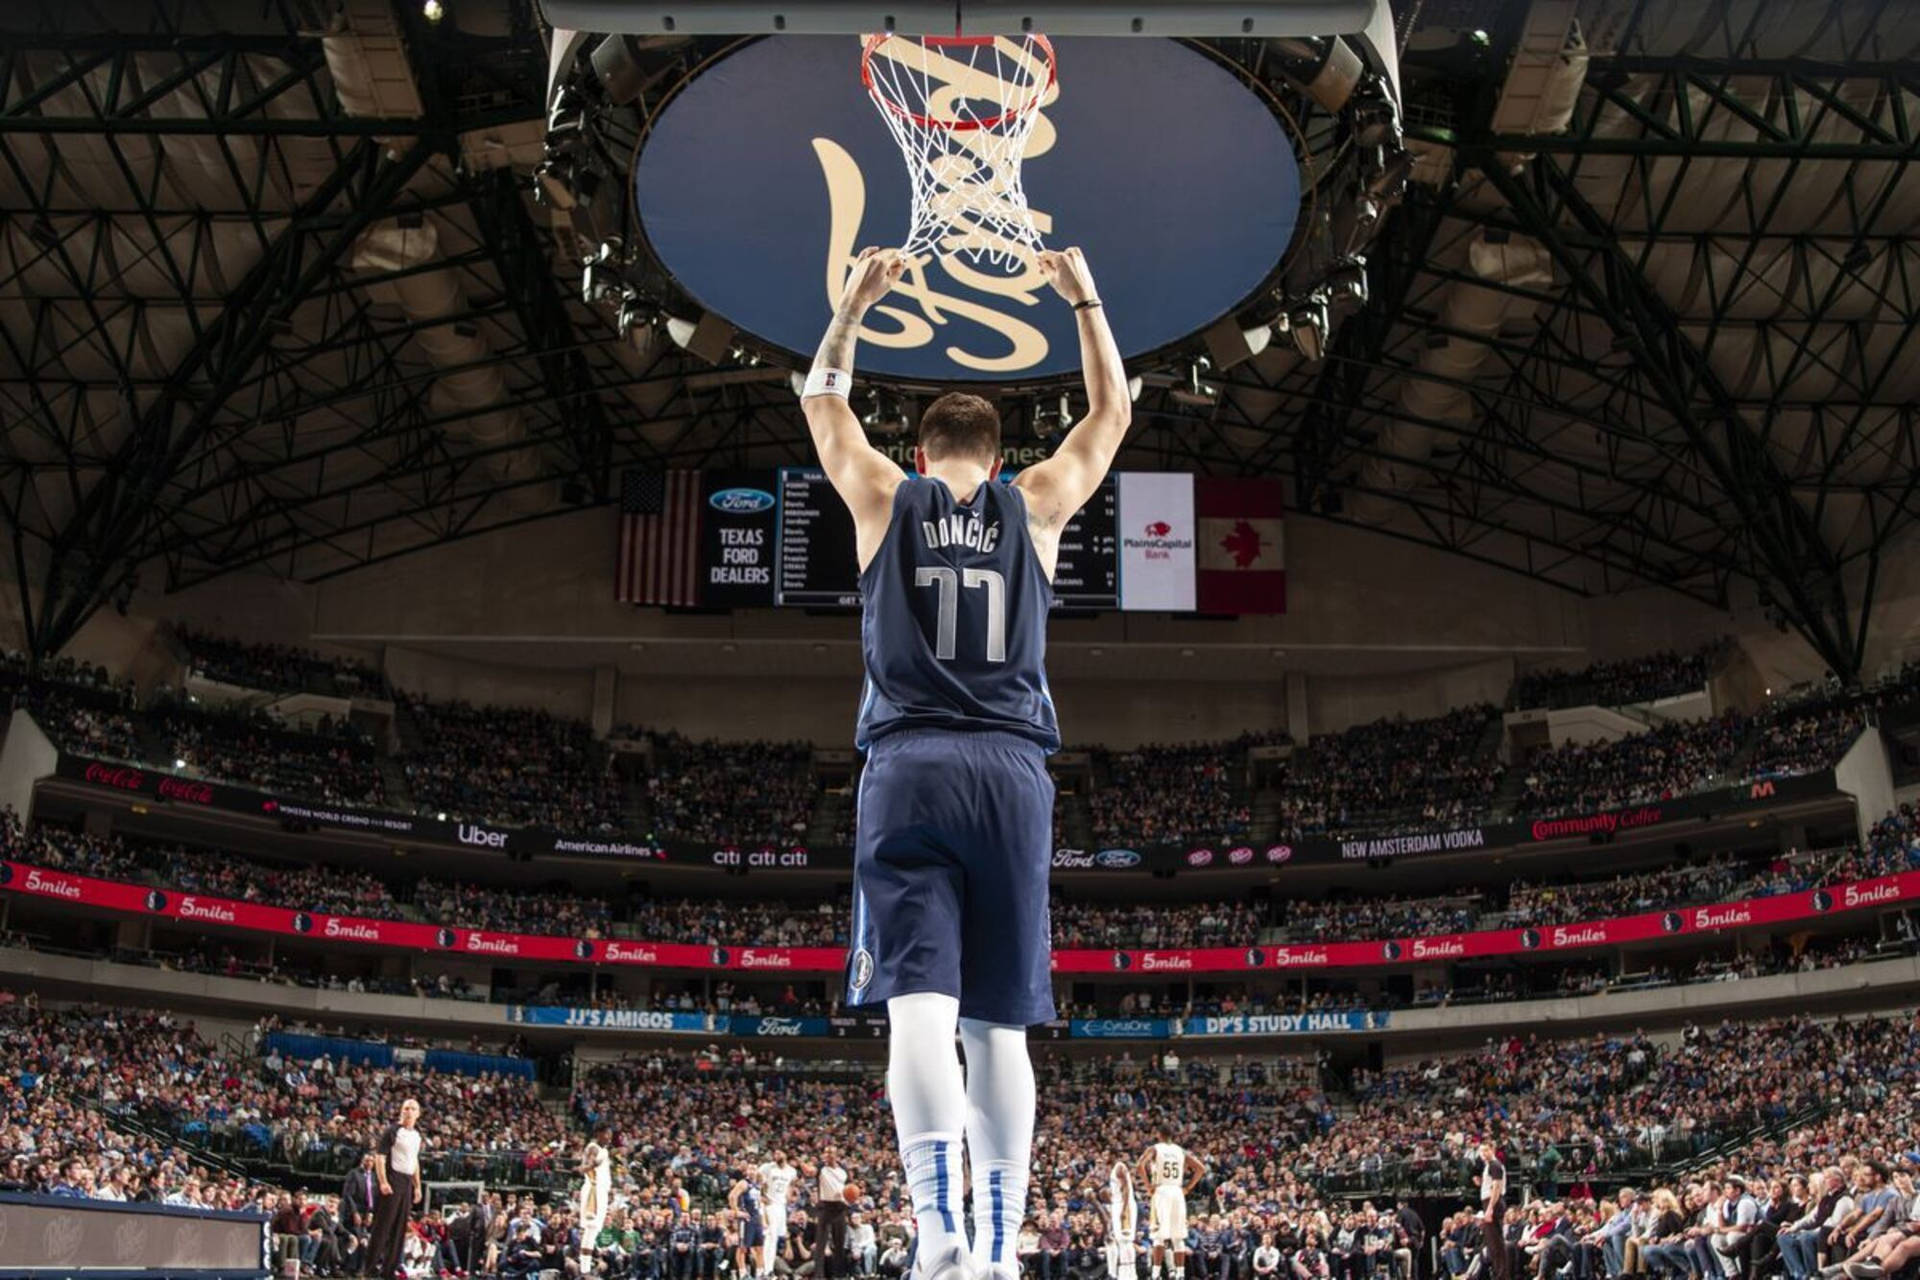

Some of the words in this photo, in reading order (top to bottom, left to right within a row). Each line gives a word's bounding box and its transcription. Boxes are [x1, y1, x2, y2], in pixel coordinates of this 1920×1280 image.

[719, 528, 764, 545] TEXAS
[922, 511, 1000, 553] DONČIĆ
[1123, 538, 1192, 550] PlainsCapital
[723, 547, 759, 564] FORD
[1144, 549, 1170, 560] Bank
[710, 567, 770, 584] DEALERS
[914, 565, 1006, 663] 77
[312, 811, 340, 821] WORLD
[458, 823, 509, 848] Uber
[1532, 812, 1618, 841] Community
[1342, 841, 1368, 858] NEW
[1369, 834, 1442, 857] AMSTERDAM
[1443, 829, 1484, 848] VODKA
[713, 849, 740, 865] citi
[748, 850, 775, 866] citi
[781, 850, 807, 866] citi
[1052, 848, 1096, 868] Ford
[25, 870, 80, 899] 5miles
[1844, 887, 1900, 907] 5miles
[179, 897, 235, 921] 5miles
[1695, 909, 1751, 928] 5miles
[324, 919, 379, 940] 5miles
[1553, 927, 1607, 946] 5miles
[467, 933, 519, 954] 5miles
[605, 943, 657, 962] 5miles
[1412, 940, 1465, 958] 5miles
[741, 950, 791, 967] 5miles
[1142, 953, 1192, 970] 5miles
[1277, 948, 1328, 966] 5miles
[565, 1008, 602, 1026] JJ'S
[603, 1010, 675, 1029] AMIGOS
[757, 1016, 802, 1036] Ford
[1206, 1017, 1244, 1033] DP'S
[1247, 1015, 1304, 1032] STUDY
[1308, 1014, 1352, 1030] HALL
[1162, 1161, 1180, 1179] 55
